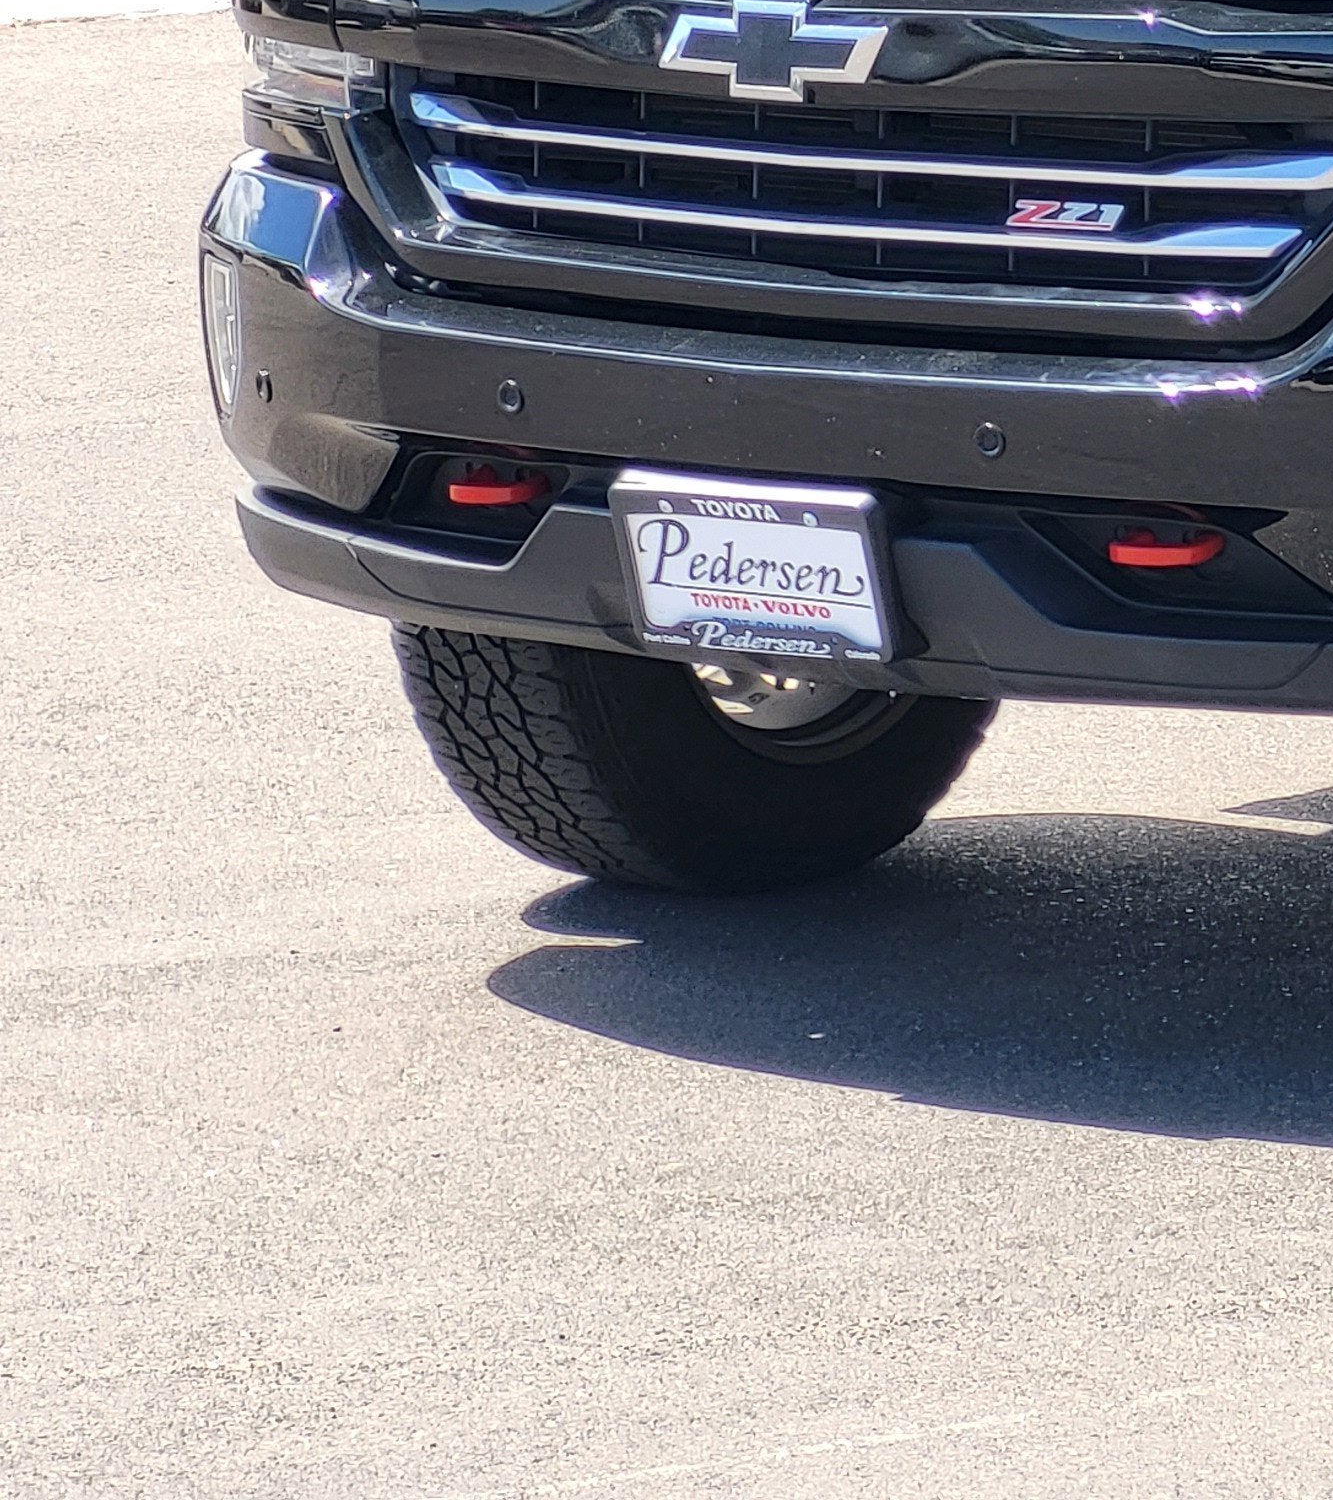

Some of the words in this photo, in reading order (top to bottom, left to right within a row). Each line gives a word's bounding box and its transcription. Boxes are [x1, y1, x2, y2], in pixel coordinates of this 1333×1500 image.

[1006, 199, 1124, 231] Z71
[690, 498, 781, 522] TOYOTA
[637, 518, 864, 597] Pedersen
[690, 592, 751, 612] TOYOTA
[760, 600, 832, 618] VOLVO
[691, 620, 832, 655] Pedersen
